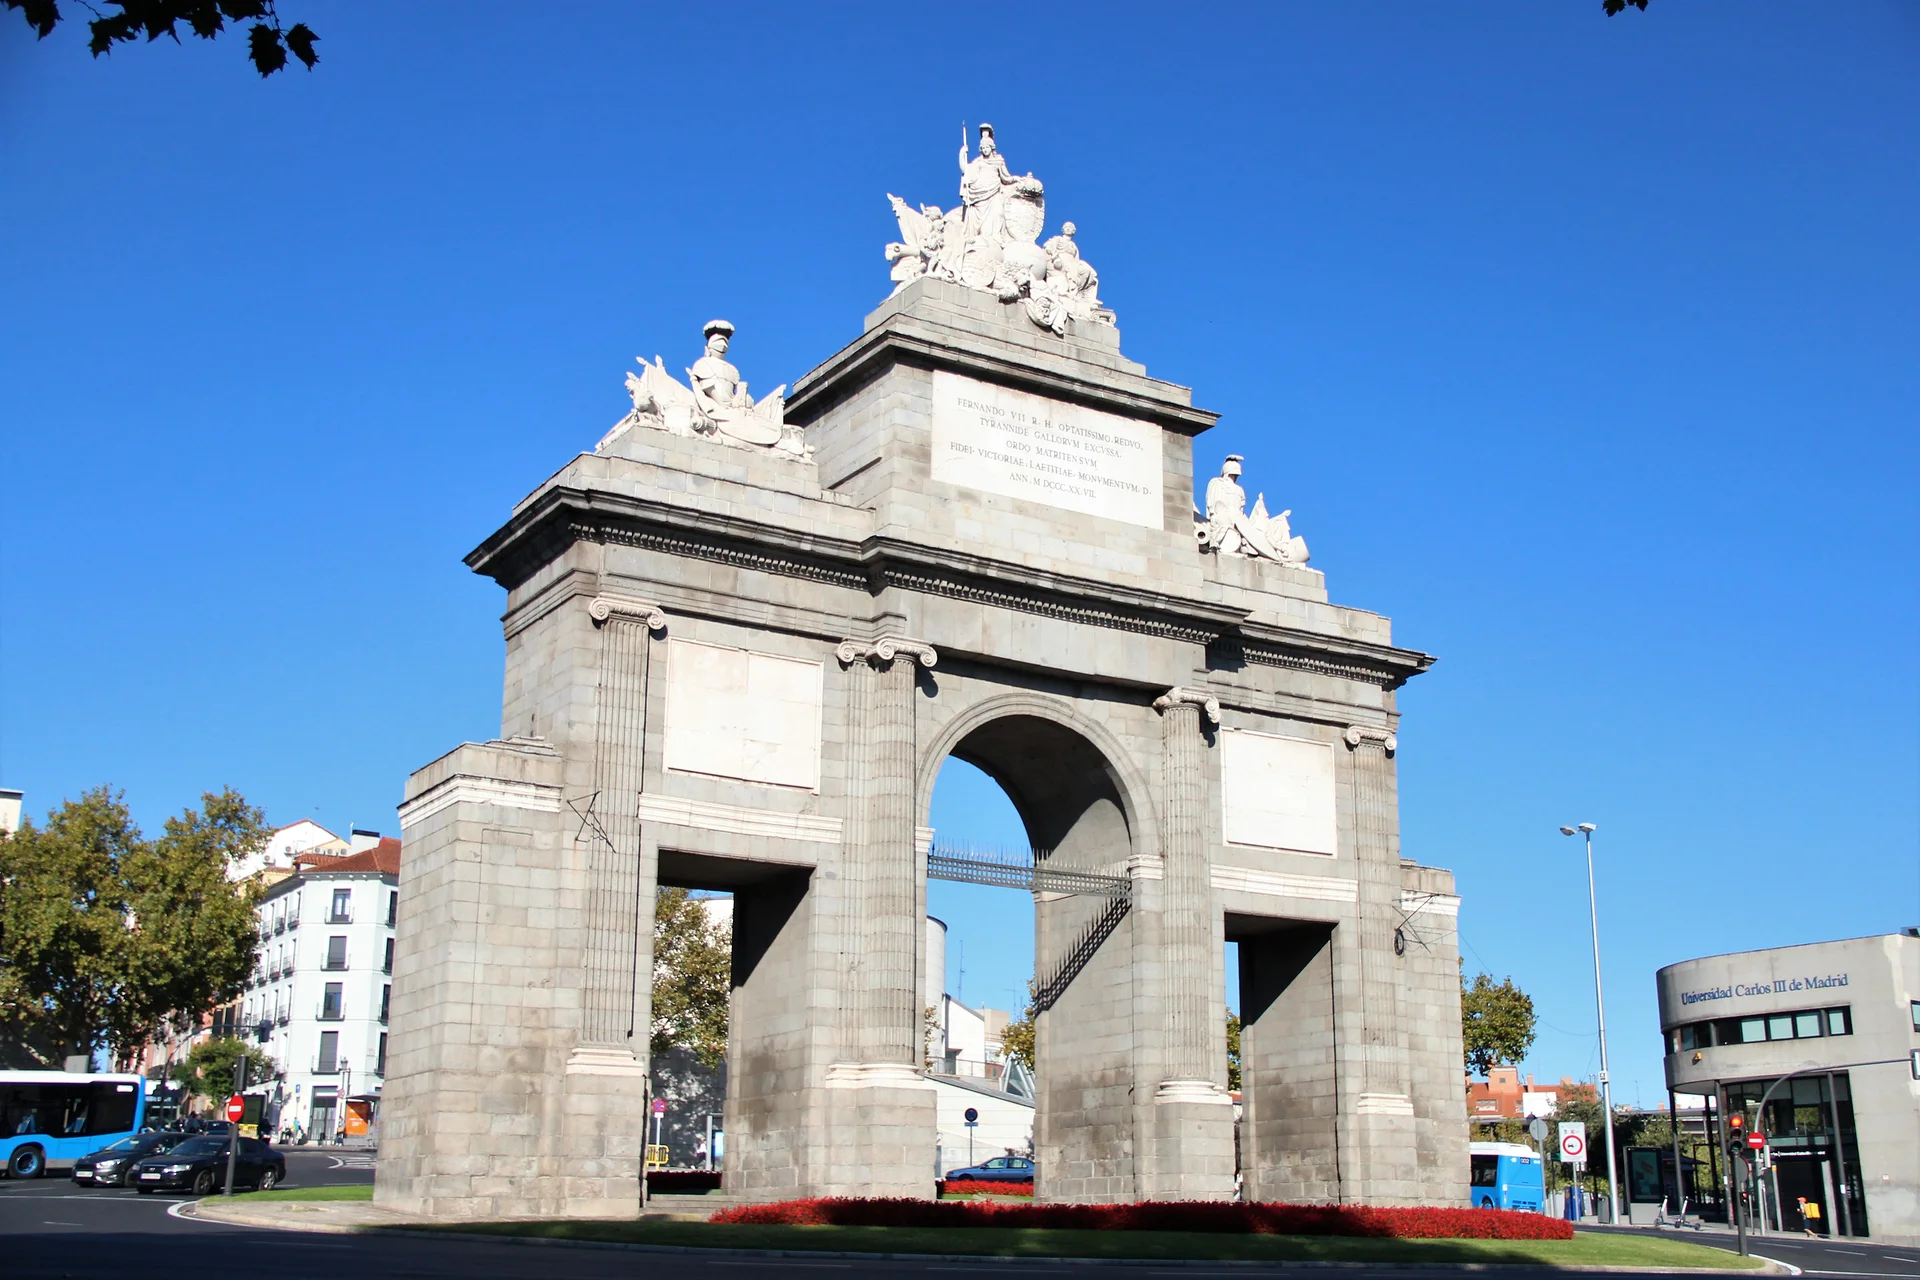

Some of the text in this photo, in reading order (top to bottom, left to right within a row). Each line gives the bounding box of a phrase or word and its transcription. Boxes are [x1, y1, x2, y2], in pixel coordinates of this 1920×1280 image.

[957, 398, 1005, 416] FERNANDO
[1010, 411, 1026, 422] VII
[980, 417, 1029, 436] TYRANNIDE
[1034, 431, 1080, 448] GALLORVM
[1005, 440, 1031, 453] ORDO
[1681, 973, 1849, 1006] Universidad Carlos III de Madrid
